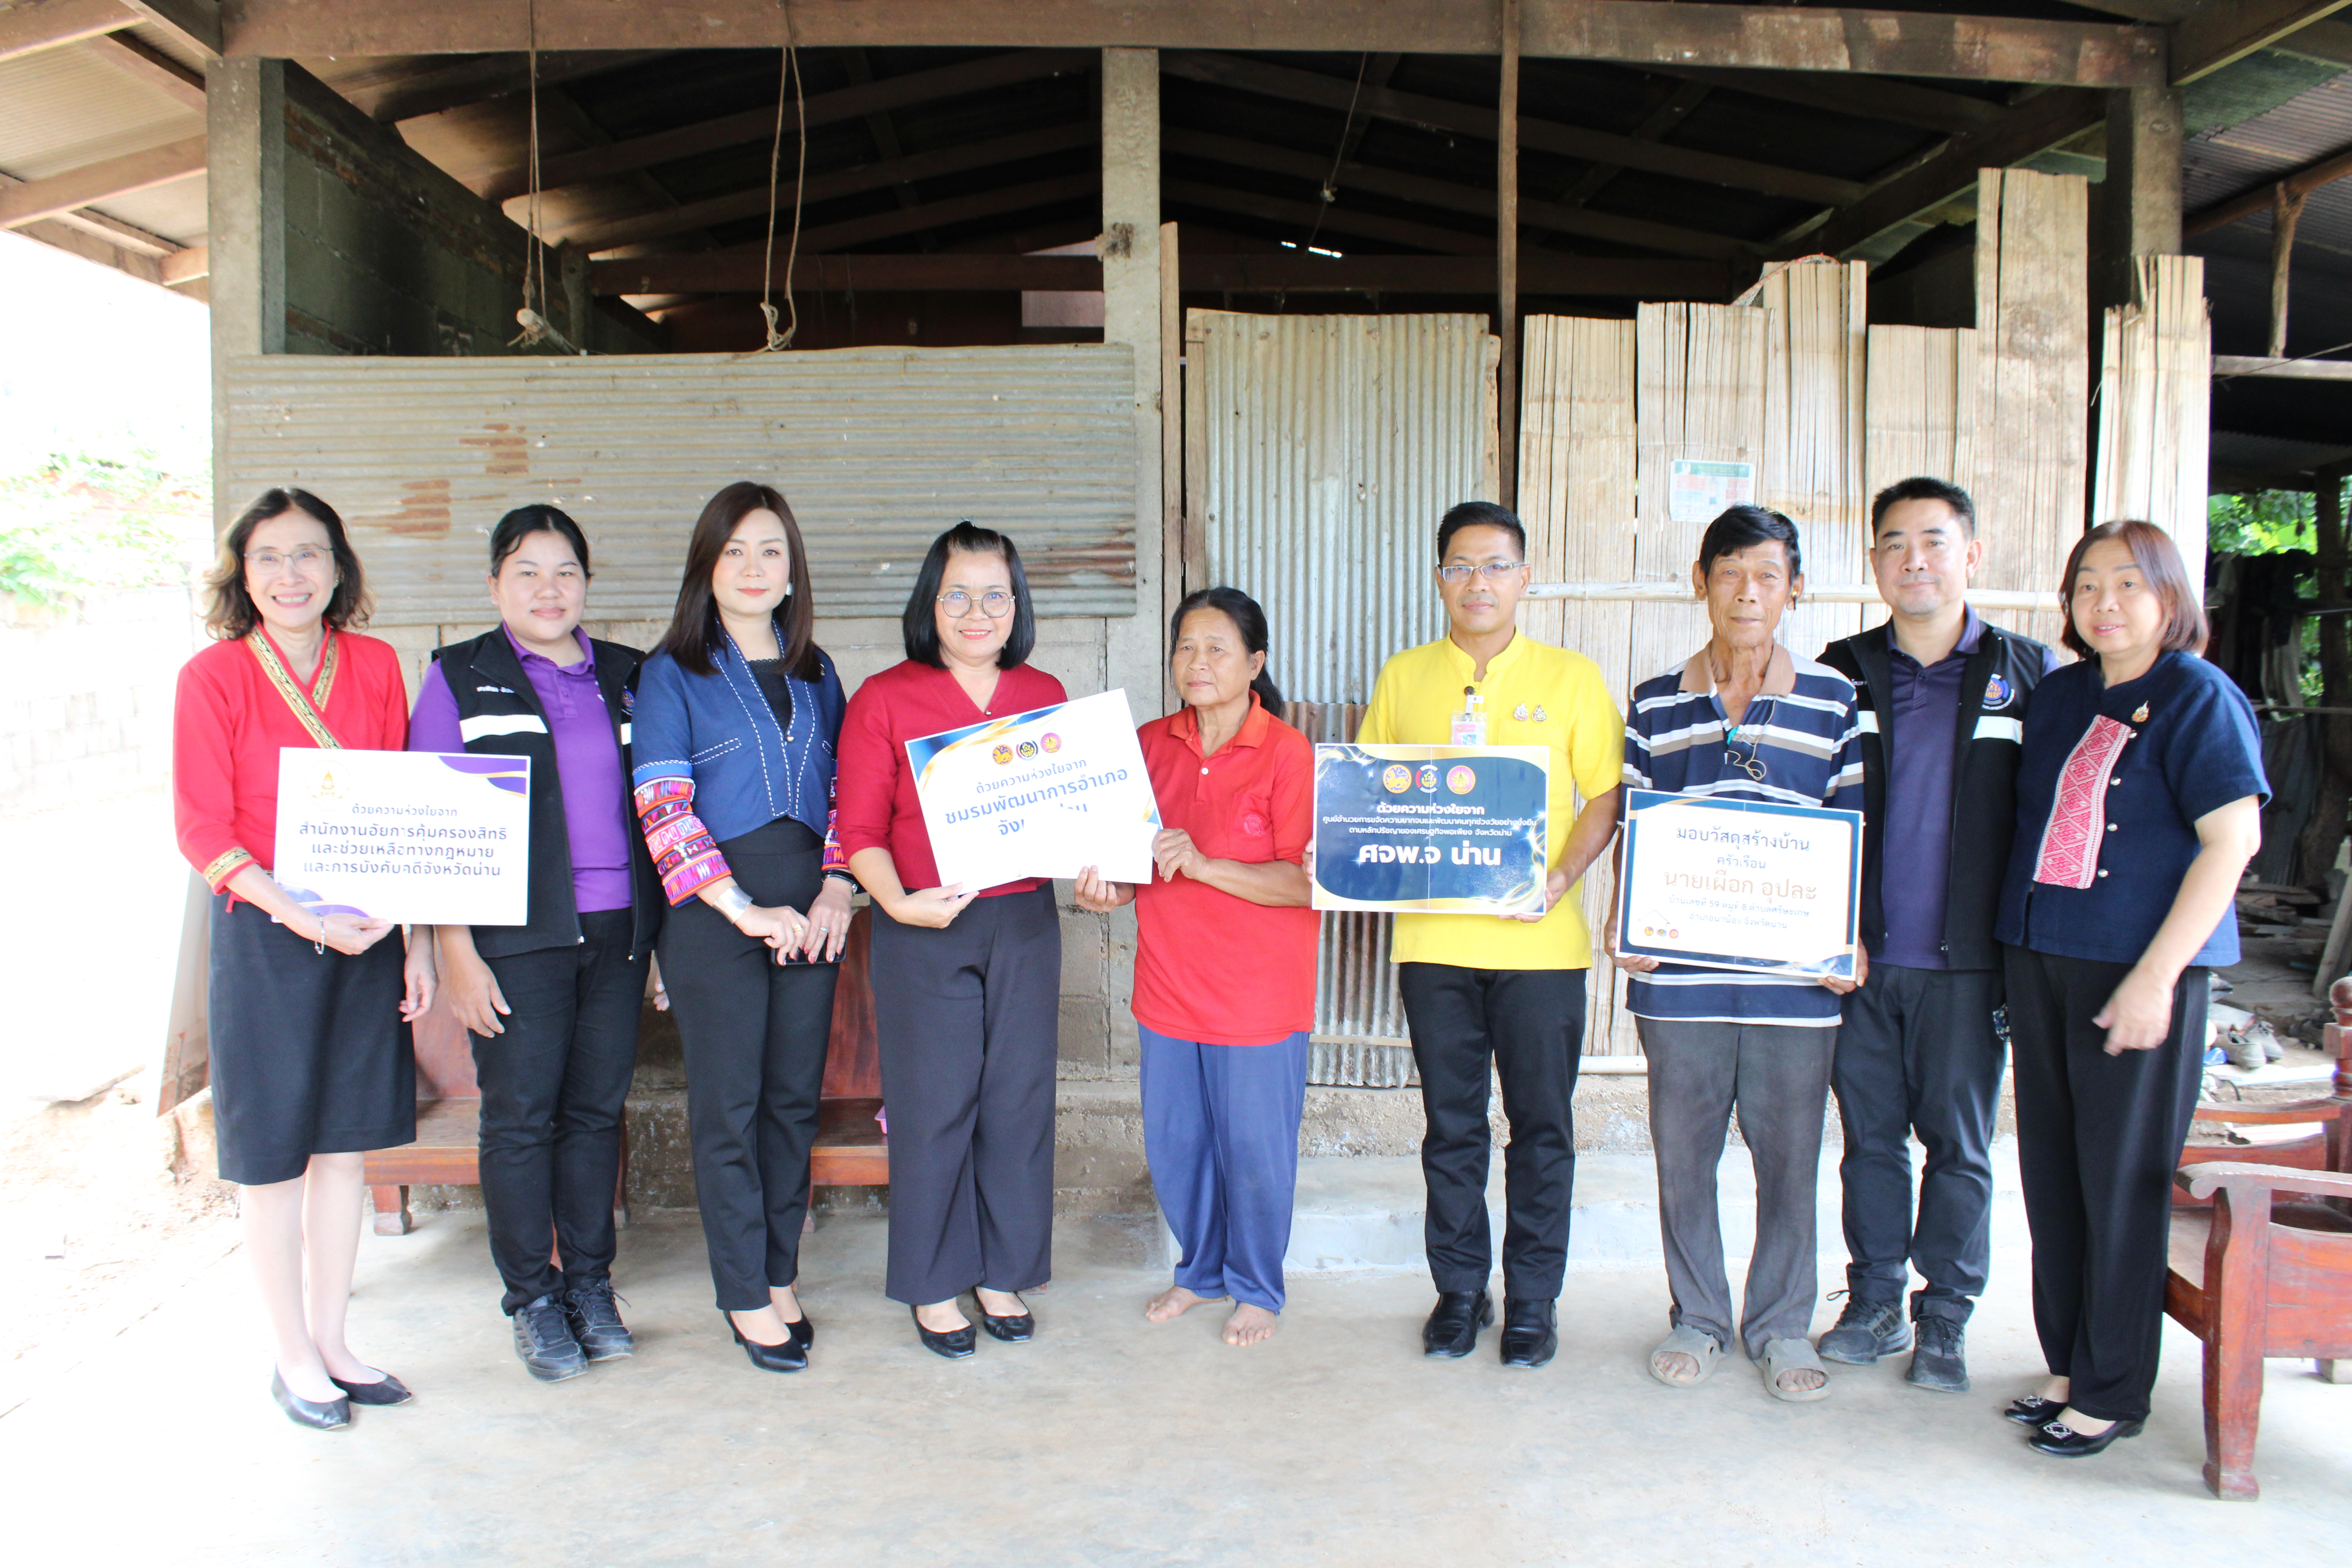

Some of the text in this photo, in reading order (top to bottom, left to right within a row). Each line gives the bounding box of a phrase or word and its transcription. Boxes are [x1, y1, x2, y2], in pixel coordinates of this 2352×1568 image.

[977, 760, 1086, 793] ด้วยความห่วงใยจาก
[945, 769, 1127, 824] ชมรมพัฒนาการอำเภอ
[352, 803, 457, 816] ด้วยความห่วงใยจาก
[1377, 802, 1484, 814] ด้วยความห่วงใยจาก
[299, 821, 506, 841] สำนักงานอัยการคุ้มครองสิทธิ
[1350, 827, 1472, 836] ตามหลักปรัชญาของเศรษฐกิจพอเพียง
[1677, 826, 1810, 851] มอบวัสดุสร้างบ้าน
[312, 841, 493, 860] และช่วยเหลือทางกฎหมาย
[1359, 841, 1500, 865] ศจพ.จ น่าน
[304, 860, 500, 876] และการบังคับคดีจังหวัดน่าน
[1717, 854, 1766, 869] ครัวเรือน
[1664, 869, 1817, 904] นายเผือก อุปละ
[1744, 916, 1788, 929] จังหวัดน่าน
